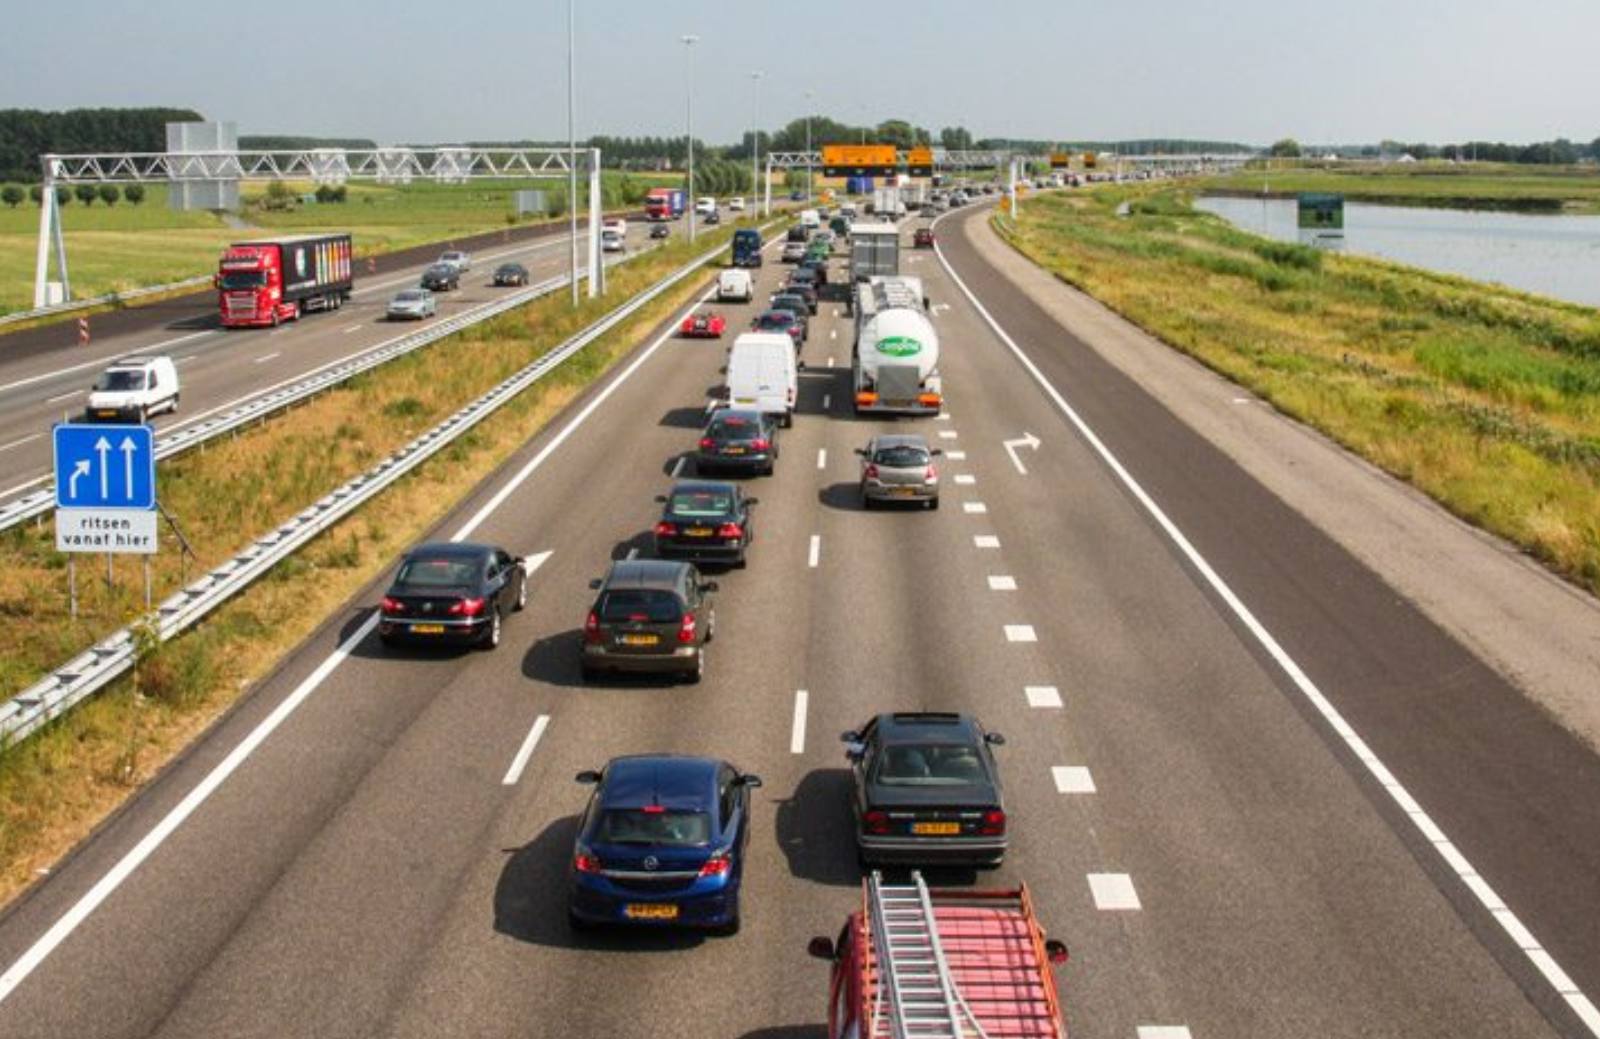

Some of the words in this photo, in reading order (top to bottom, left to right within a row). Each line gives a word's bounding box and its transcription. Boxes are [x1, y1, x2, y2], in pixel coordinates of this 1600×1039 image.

[81, 517, 130, 529] ritsen
[63, 533, 110, 545] vanaf
[116, 533, 149, 545] hier
